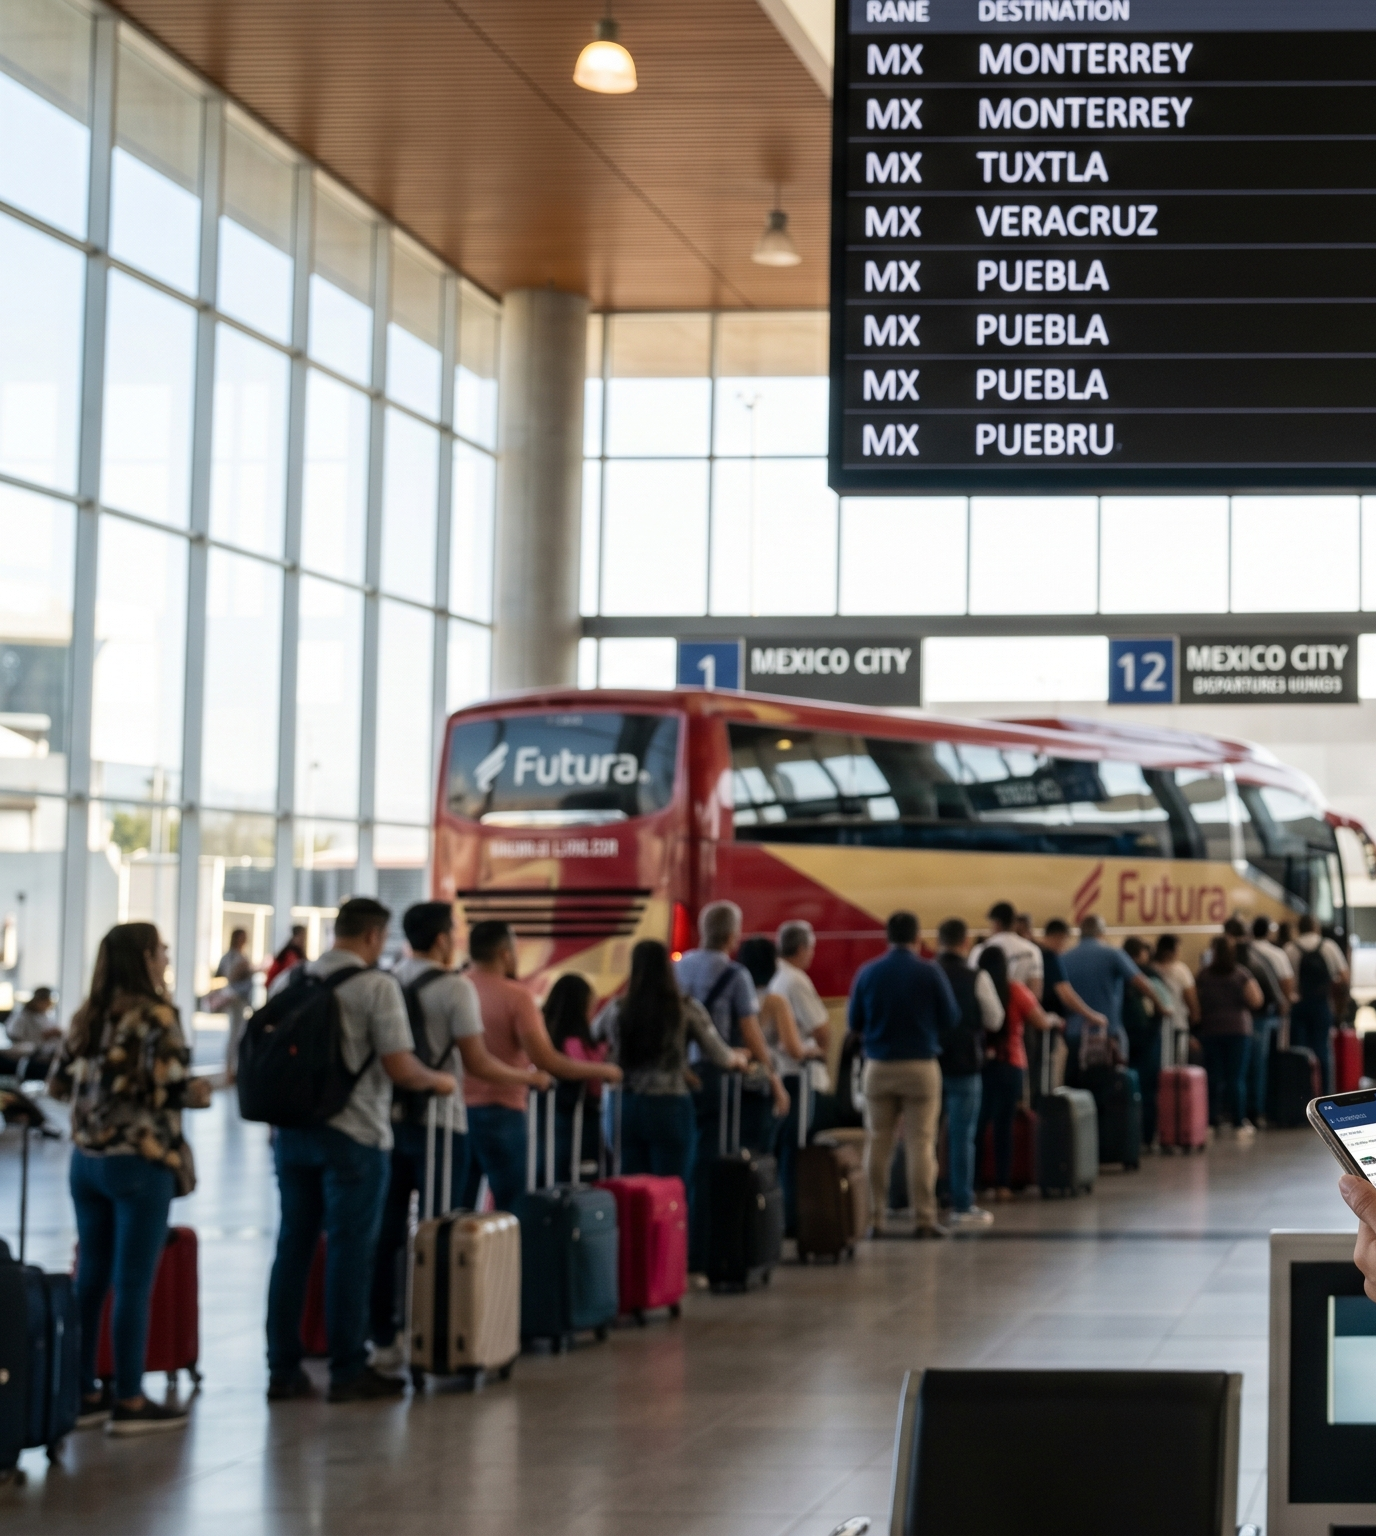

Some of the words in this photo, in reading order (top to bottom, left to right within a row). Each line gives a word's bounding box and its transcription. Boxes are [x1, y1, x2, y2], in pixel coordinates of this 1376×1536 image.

[866, 0, 931, 23] RANE
[978, 0, 1131, 22] DESTINATION
[867, 44, 923, 75] MX
[980, 42, 1193, 74] MONTERREY
[867, 98, 922, 129] MX
[979, 97, 1192, 129] MONTERREY
[866, 152, 922, 183] MX
[976, 151, 1108, 183] TUXTLA
[866, 206, 921, 237] MX
[976, 205, 1158, 236] VERACRUZ
[865, 260, 920, 292] MX
[978, 260, 1109, 292] PUEBLA
[864, 315, 920, 346] MX
[977, 314, 1109, 346] PUEBLA
[864, 369, 919, 401] MX
[976, 368, 1108, 400] PUEBLA
[863, 424, 919, 456] MX
[976, 423, 1114, 456] PUEBRU
[696, 654, 716, 692] 1
[751, 647, 850, 675] MEXICO
[853, 647, 912, 675] CITY
[1116, 652, 1168, 692] 12
[1186, 645, 1287, 672] MEXICO
[1290, 644, 1350, 671] CITY
[1116, 869, 1228, 925] Futura
